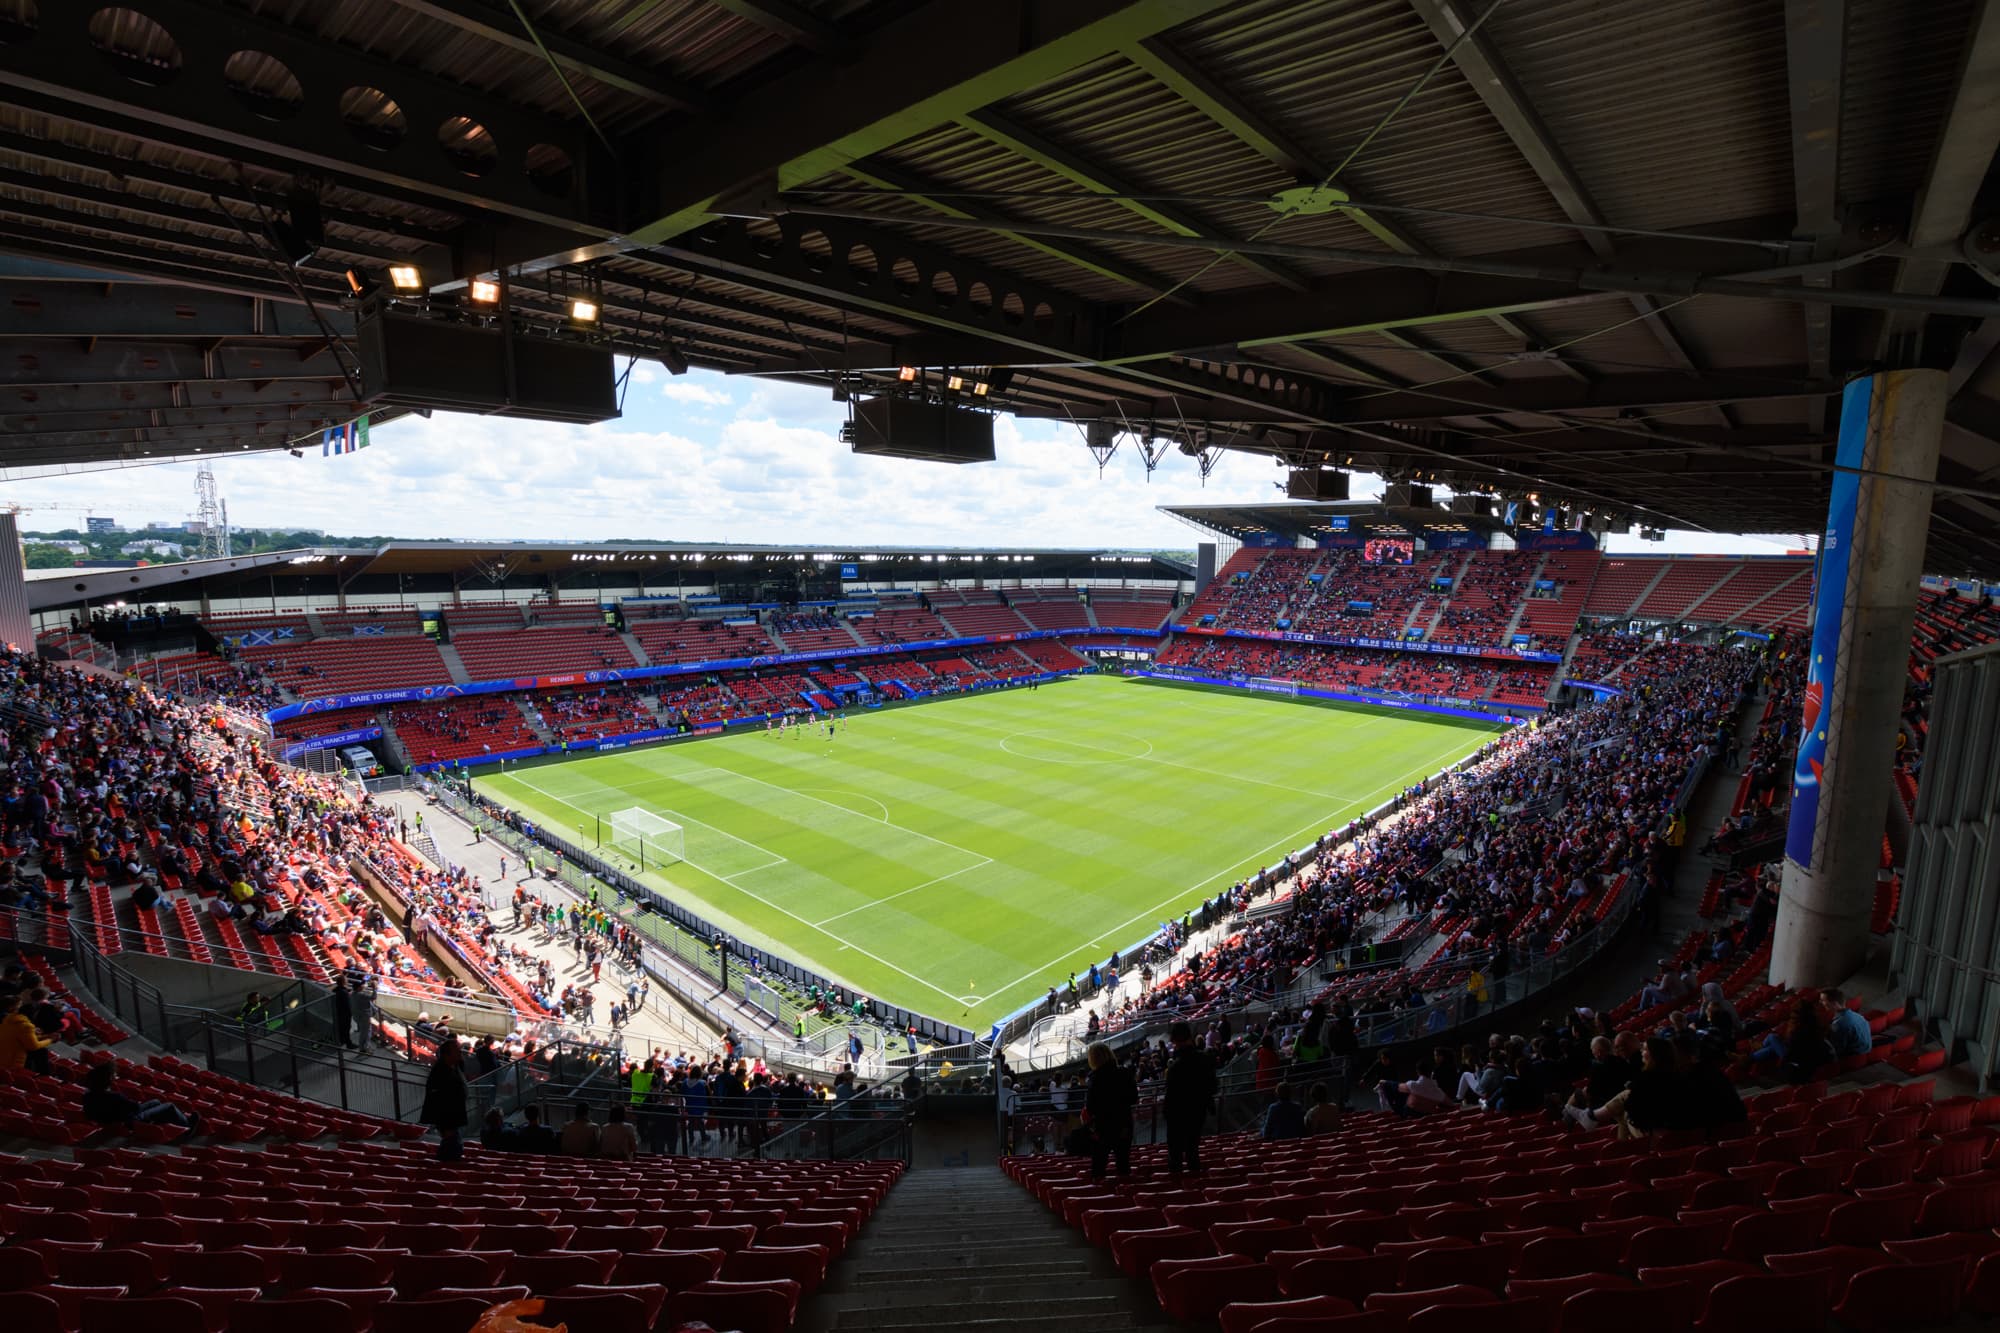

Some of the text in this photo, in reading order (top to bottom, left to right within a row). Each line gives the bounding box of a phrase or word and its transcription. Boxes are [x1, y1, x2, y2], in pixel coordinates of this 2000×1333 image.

[350, 694, 371, 703] DARE
[383, 691, 408, 699] SHINE
[323, 735, 346, 745] FRANCE
